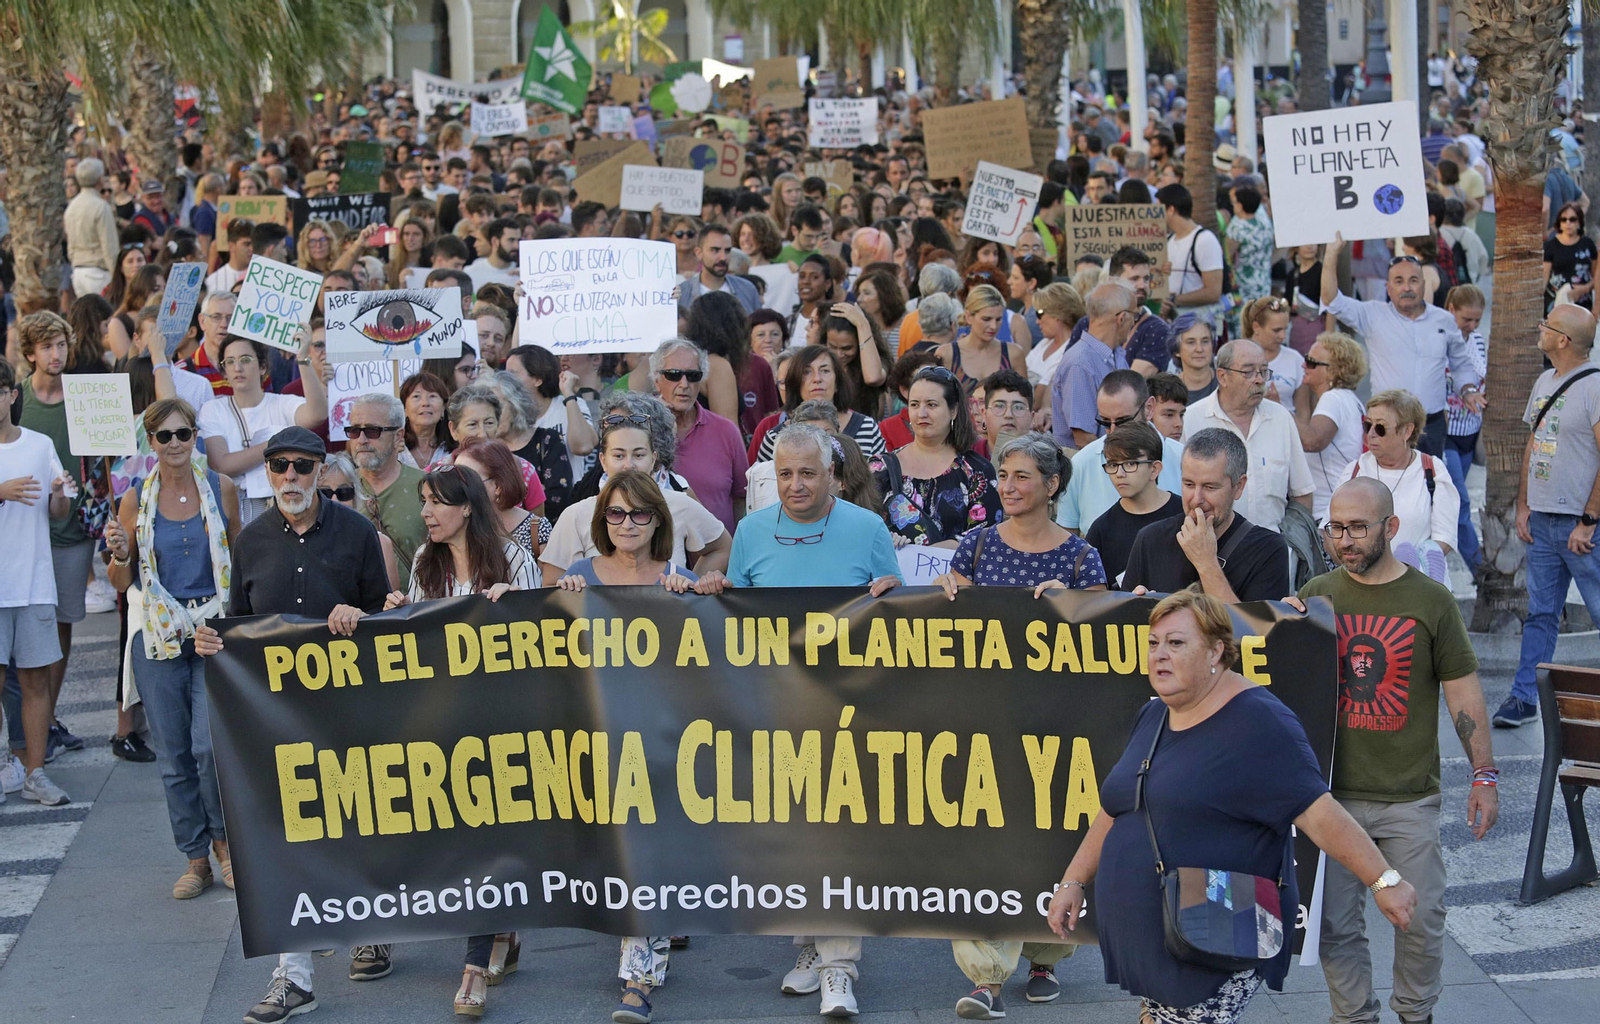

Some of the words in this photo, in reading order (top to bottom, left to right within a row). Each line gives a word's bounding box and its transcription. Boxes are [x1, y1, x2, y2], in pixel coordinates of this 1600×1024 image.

[1292, 126, 1324, 146] NO
[1333, 120, 1392, 143] HAY
[720, 144, 740, 177] B
[626, 184, 645, 196] QUE
[978, 170, 1015, 190] NUESTRO
[307, 196, 340, 208] WHAT
[348, 194, 374, 206] WE
[975, 182, 1014, 203] PLANETA
[1333, 175, 1359, 210] B
[970, 207, 994, 222] ESTE
[972, 194, 985, 207] ES
[986, 199, 1010, 214] COMO
[1072, 207, 1136, 223] NUESTRA
[1137, 206, 1165, 219] CASA
[966, 219, 1000, 237] CARTÓN
[1073, 227, 1101, 239] ESTA
[1108, 226, 1123, 237] EN
[1073, 241, 1081, 254] Y
[528, 250, 557, 276] LOS
[561, 249, 585, 272] QUE
[622, 247, 675, 280] CIMA
[246, 262, 322, 302] RESPECT
[592, 273, 606, 285] EN
[606, 271, 618, 282] LA
[255, 288, 303, 322] YOUR
[328, 291, 358, 311] ABRE
[526, 294, 555, 321] NO
[555, 294, 570, 314] SE
[573, 290, 627, 312] ENTERAN
[631, 290, 648, 307] NI
[427, 317, 463, 347] MUNDO
[552, 310, 629, 343] CLIMA
[74, 415, 86, 426] ES
[91, 413, 128, 425] NUESTRO
[263, 639, 364, 692] POR
[374, 632, 434, 683] EL
[444, 617, 660, 678] DERECHO
[675, 618, 710, 667] A
[724, 617, 790, 667] UN
[805, 612, 1013, 668] PLANETA
[1026, 618, 1272, 687] SALUE
[275, 728, 657, 843] EMERGENCIA
[676, 704, 1005, 828] CLIMÁTICA
[1021, 734, 1101, 831] YA
[290, 876, 528, 927] Asociación
[541, 870, 598, 906] Pro
[604, 875, 807, 911] Derechos
[822, 875, 1023, 916] Humanos
